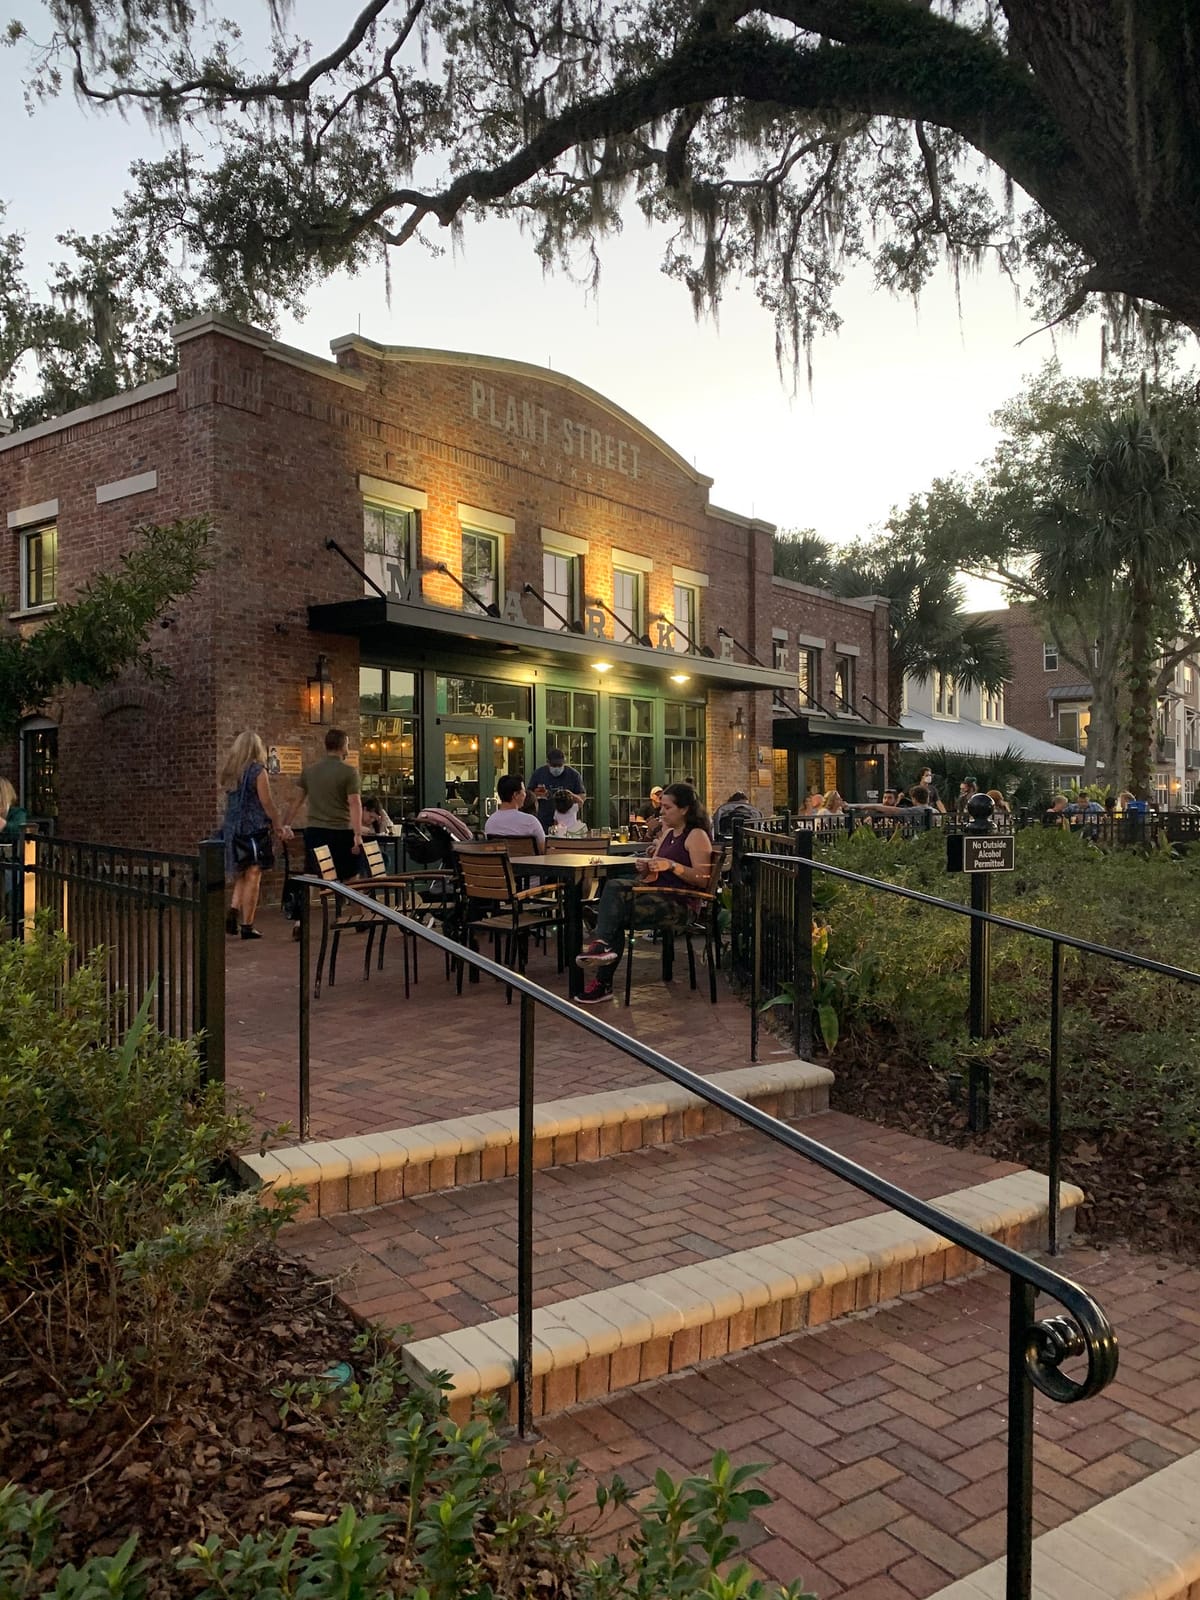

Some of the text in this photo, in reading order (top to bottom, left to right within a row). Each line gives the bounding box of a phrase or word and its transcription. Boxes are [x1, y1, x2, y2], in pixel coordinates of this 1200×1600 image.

[472, 379, 641, 480] PLANT STREET
[521, 451, 607, 490] MARKET
[386, 562, 789, 671] MARKET
[474, 703, 494, 716] 426
[972, 840, 1007, 849] No Outside
[978, 850, 1001, 858] Alcohol
[974, 859, 1004, 868] Permitted
